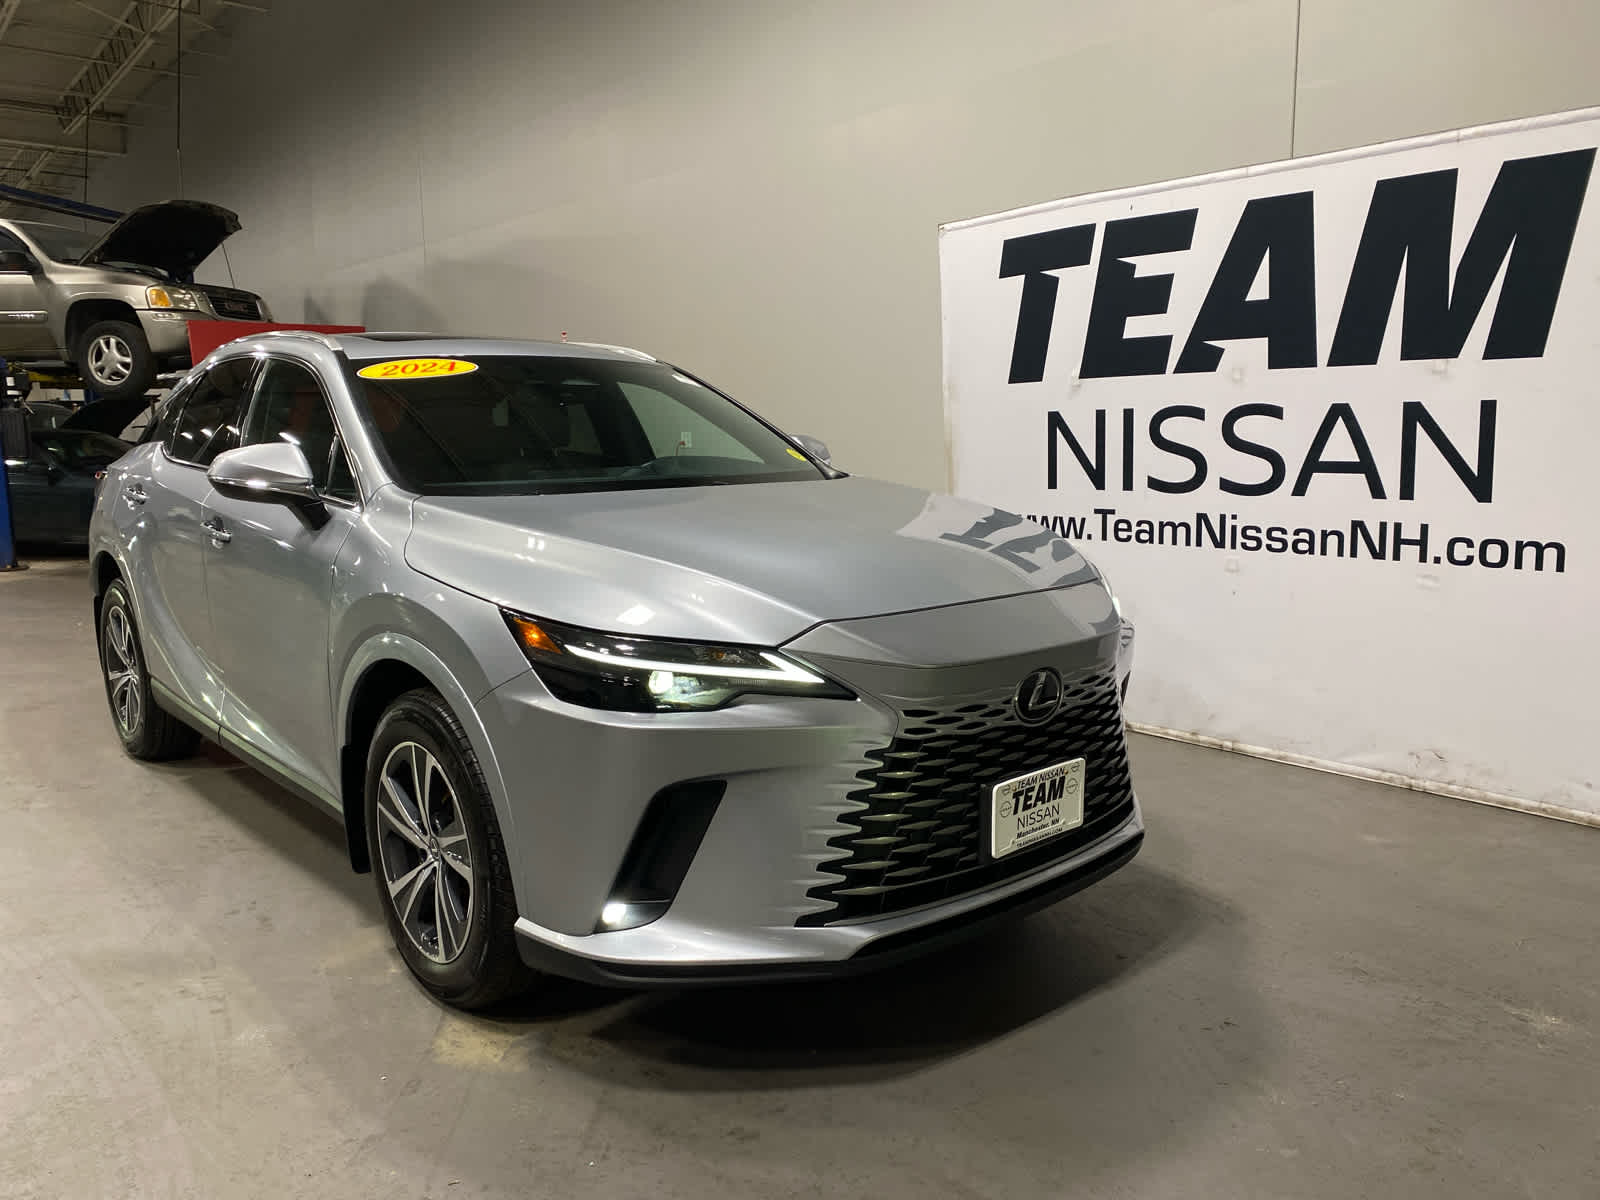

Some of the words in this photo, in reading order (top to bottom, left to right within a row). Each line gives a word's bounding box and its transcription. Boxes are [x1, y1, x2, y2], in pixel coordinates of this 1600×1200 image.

[999, 147, 1597, 384] TEAM
[380, 361, 457, 377] 2024
[1046, 399, 1498, 503] NISSAN
[1012, 775, 1066, 816] TEAM
[1017, 776, 1038, 790] TEAM
[1039, 767, 1065, 782] NISSAN
[1017, 803, 1060, 831] NISSAN
